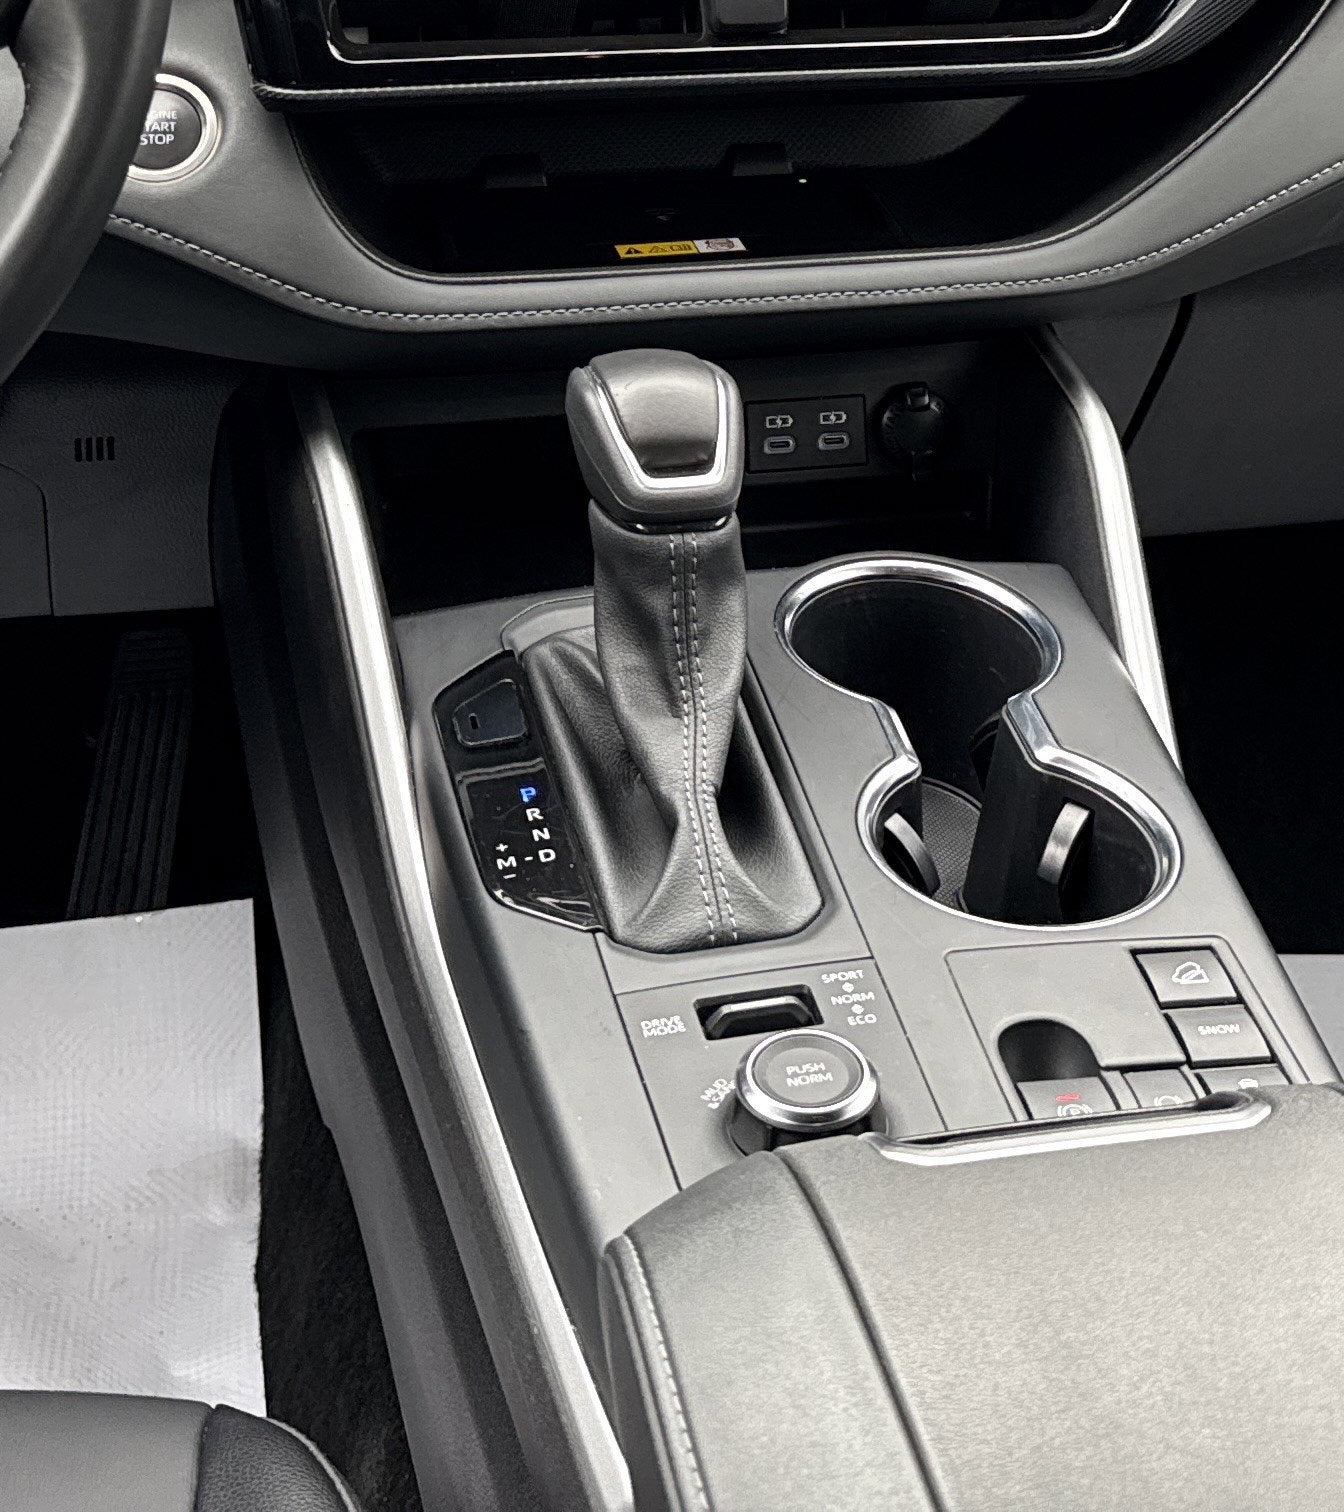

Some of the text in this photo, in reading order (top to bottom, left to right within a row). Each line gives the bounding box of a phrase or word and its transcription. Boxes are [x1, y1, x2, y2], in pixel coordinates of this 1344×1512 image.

[144, 122, 177, 132] TART
[139, 134, 175, 146] STOP
[519, 786, 537, 803] P
[525, 807, 544, 822] R
[532, 827, 551, 842] N
[538, 848, 556, 863] D
[496, 856, 517, 870] M
[821, 969, 865, 985] SPORT
[830, 991, 875, 1005] NORM
[640, 1014, 682, 1030] DRIVE
[847, 1014, 877, 1026] ECO
[642, 1024, 687, 1038] MODE
[1197, 1023, 1240, 1036] SNOW
[785, 1061, 826, 1075] PUSH
[786, 1073, 834, 1087] NORM
[700, 1077, 728, 1103] MUD
